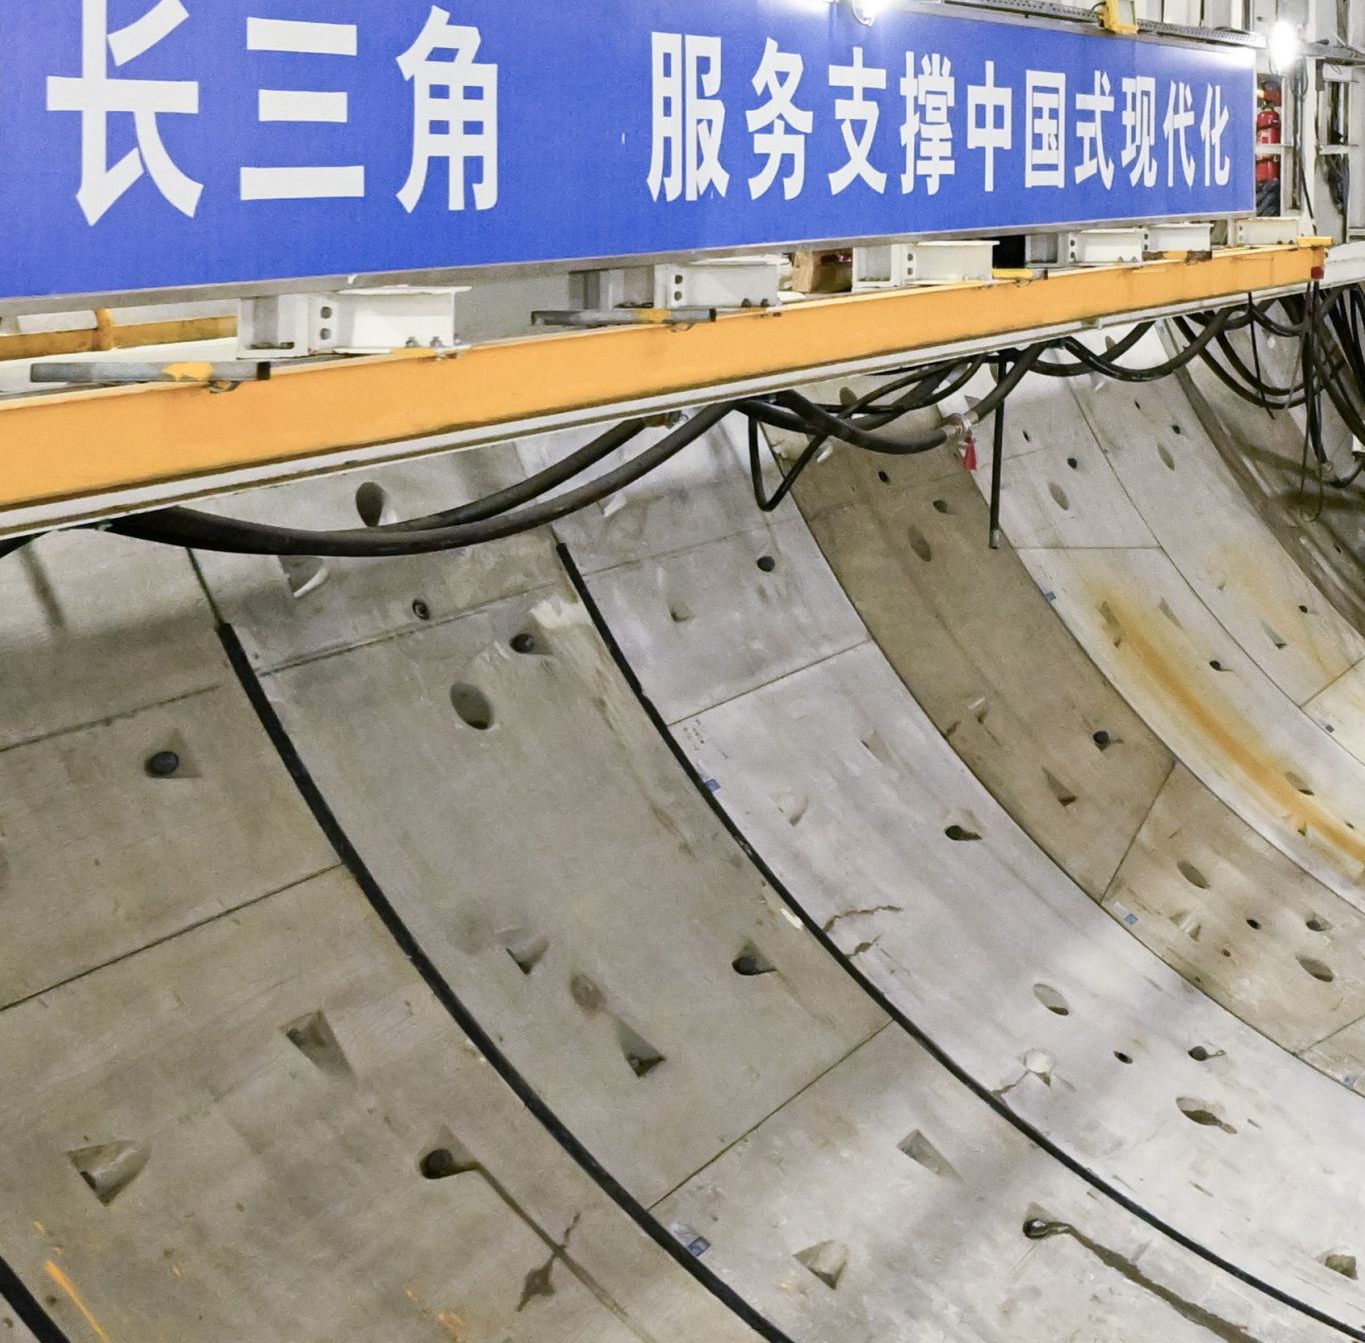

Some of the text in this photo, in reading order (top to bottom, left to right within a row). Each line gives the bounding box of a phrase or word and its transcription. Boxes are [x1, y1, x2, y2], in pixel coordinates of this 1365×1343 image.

[647, 31, 1231, 202] 服务支撑中国式现代化
